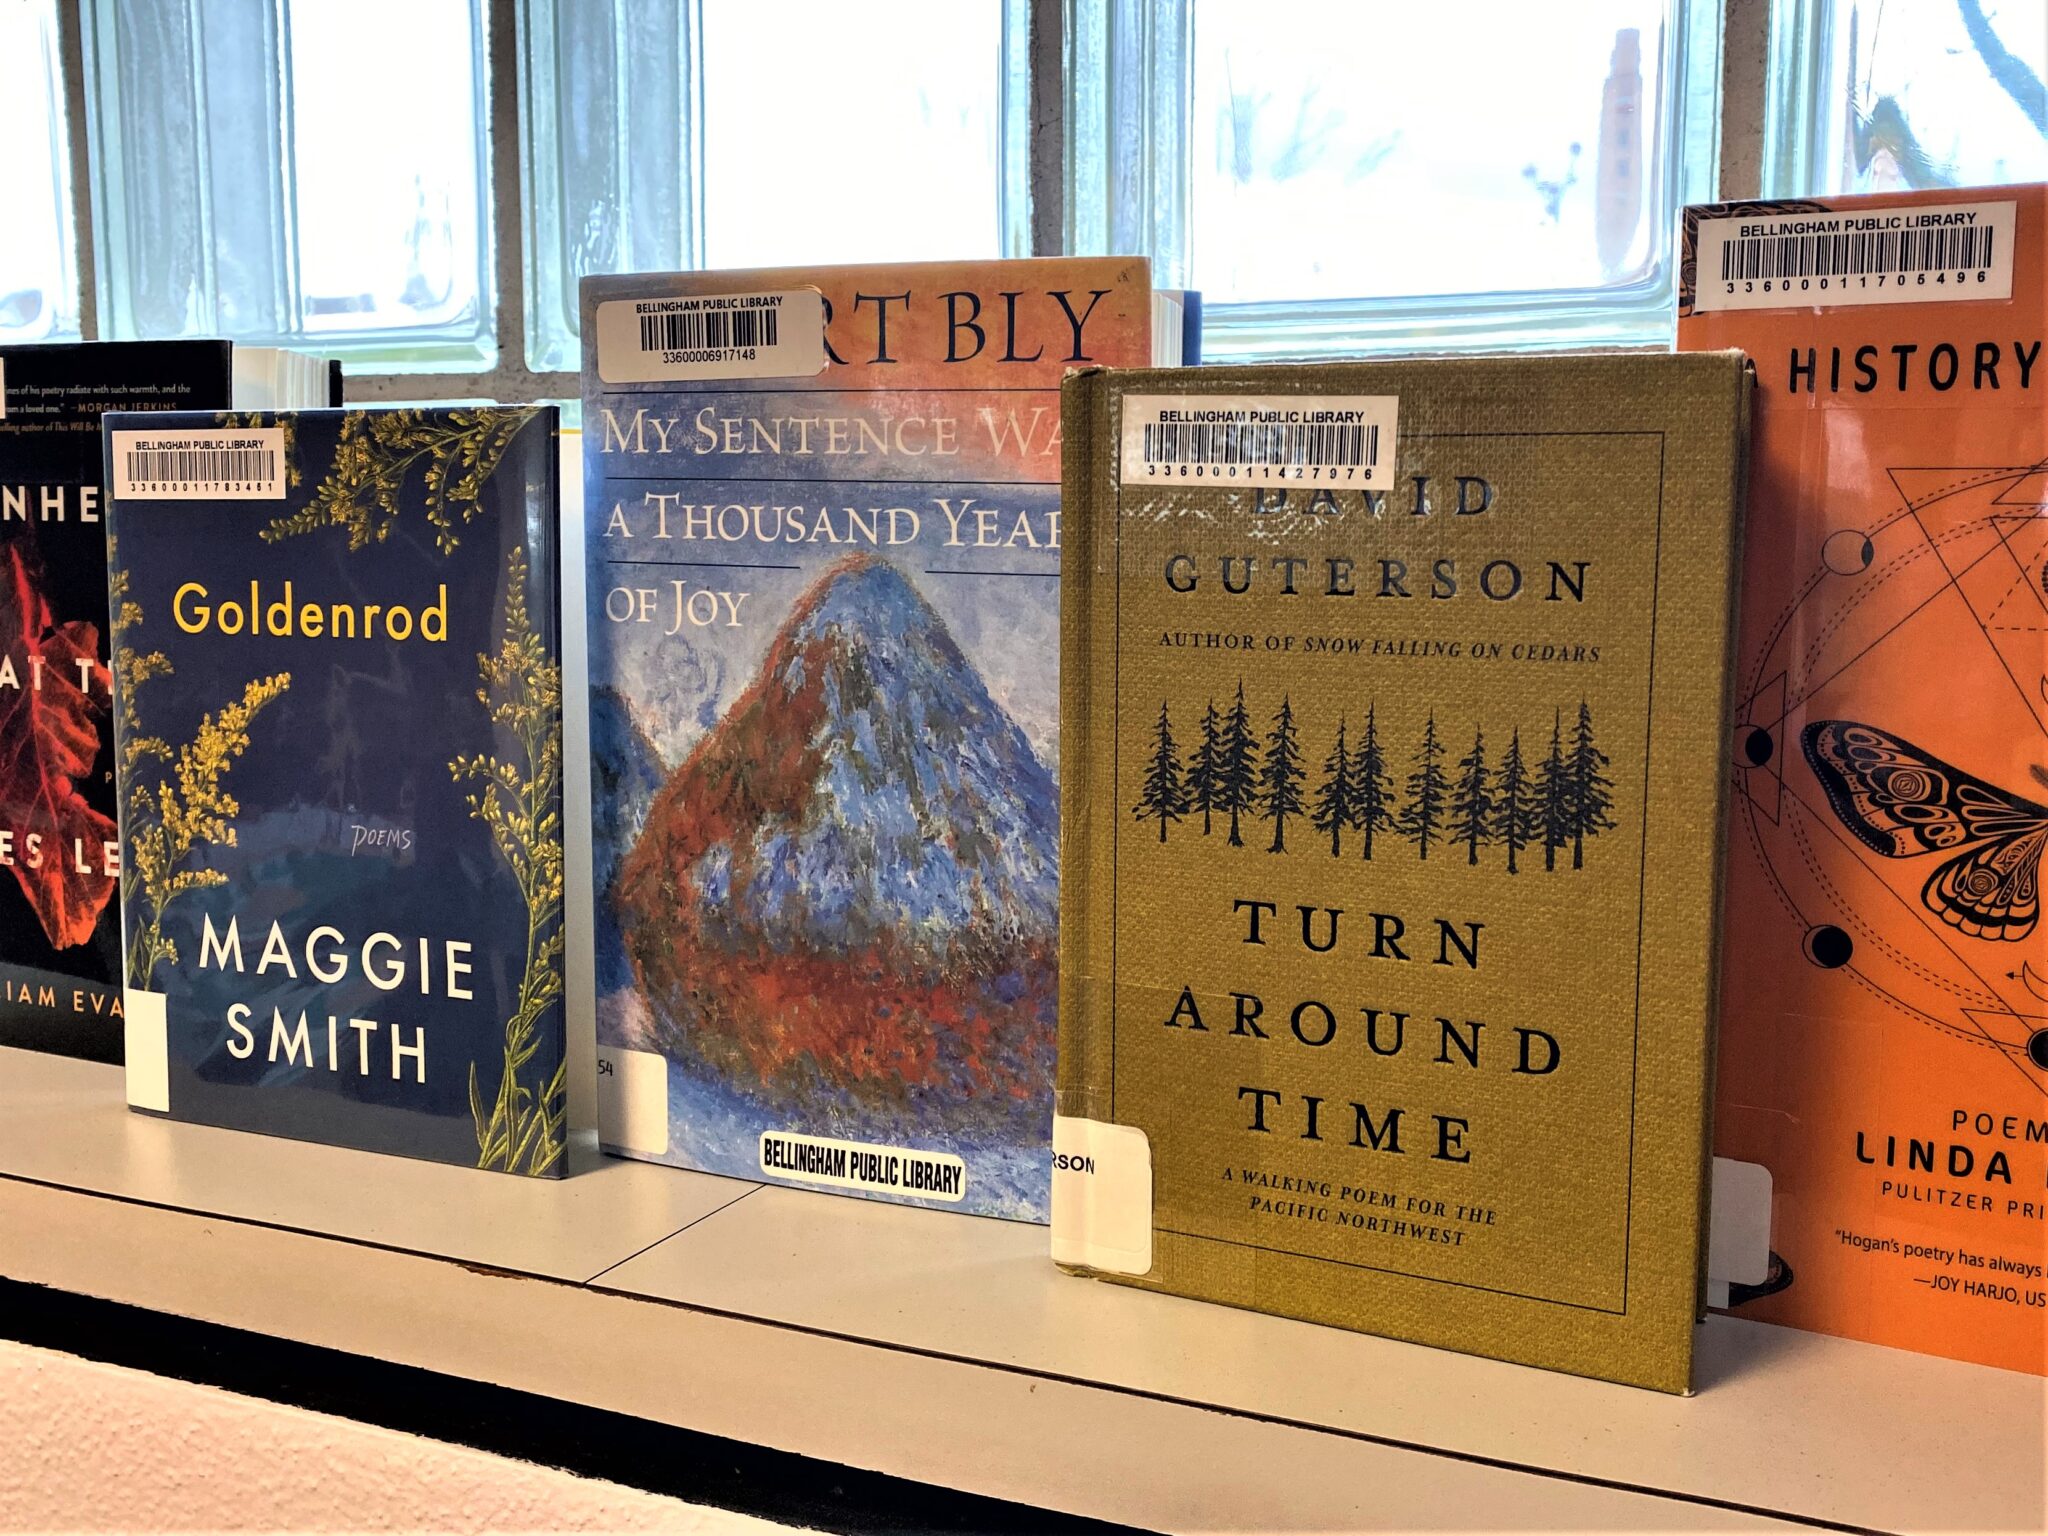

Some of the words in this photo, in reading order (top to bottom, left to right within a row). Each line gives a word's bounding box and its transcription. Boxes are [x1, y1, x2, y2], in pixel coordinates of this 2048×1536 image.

[1739, 220, 1840, 238] BELLINGHAM
[1844, 216, 1901, 232] PUBLIC
[1905, 212, 1978, 229] LIBRARY
[636, 300, 700, 314] BELLINGHAM
[703, 298, 738, 310] PUBLIC
[740, 296, 783, 308] LIBRARY
[937, 288, 1112, 364] BLY
[662, 349, 756, 364] 33600006917148
[1789, 341, 2043, 394] HISTORY
[25, 403, 45, 413] loved
[41, 386, 66, 398] poetry
[66, 384, 92, 395] radiate
[92, 384, 110, 394] with
[110, 384, 128, 394] such
[161, 383, 177, 394] and
[177, 383, 191, 394] the
[1159, 410, 1246, 423] BELLINGHAM
[1249, 411, 1300, 423] PUBLIC
[1302, 411, 1365, 423] LIBRARY
[136, 441, 191, 451] BELLINGHAM
[193, 440, 225, 450] PUBLIC
[226, 439, 265, 449] LIBRARY
[2, 485, 99, 523] NHE
[1252, 475, 1495, 516] DAVID
[1164, 554, 1592, 602] GUTERSON
[172, 579, 448, 642] Goldenrod
[1159, 631, 1255, 650] AUTHOR
[1265, 635, 1296, 651] OF
[1303, 636, 1366, 654] SNOW
[1371, 639, 1463, 658] FALLING
[1471, 642, 1503, 659] ON
[1511, 644, 1601, 662] CEDARS
[0, 653, 46, 691] AT
[351, 825, 411, 857] POEMS
[1232, 899, 1486, 970] TURN
[198, 911, 474, 1001] MAGGIE
[73, 990, 125, 1019] EVA
[225, 1001, 426, 1084] SMITH
[1163, 984, 1562, 1076] AROUND
[598, 1059, 613, 1077] 54
[1237, 1086, 1472, 1164] TIME
[1952, 1109, 2048, 1144] POEM
[763, 1138, 847, 1179] BELLINGHAM
[850, 1150, 898, 1186] PUBLIC
[902, 1158, 963, 1195] LIBRARY
[1855, 1130, 2012, 1186] LINDA
[1221, 1167, 1233, 1181] A
[1242, 1169, 1332, 1198] WALKING
[1340, 1186, 1397, 1209] POEM
[1405, 1197, 1447, 1217] FOR
[1456, 1204, 1498, 1226] THE
[1881, 1181, 1994, 1213] PULITZER
[2007, 1199, 2044, 1221] PRI
[1249, 1195, 1329, 1222] PACIFIC
[1335, 1210, 1466, 1246] NORTHWEST
[1903, 1243, 1955, 1266] poetry
[1958, 1247, 1985, 1268] has
[1988, 1255, 2042, 1279] always
[1964, 1280, 2020, 1306] HARJO,
[2025, 1290, 2047, 1308] US
